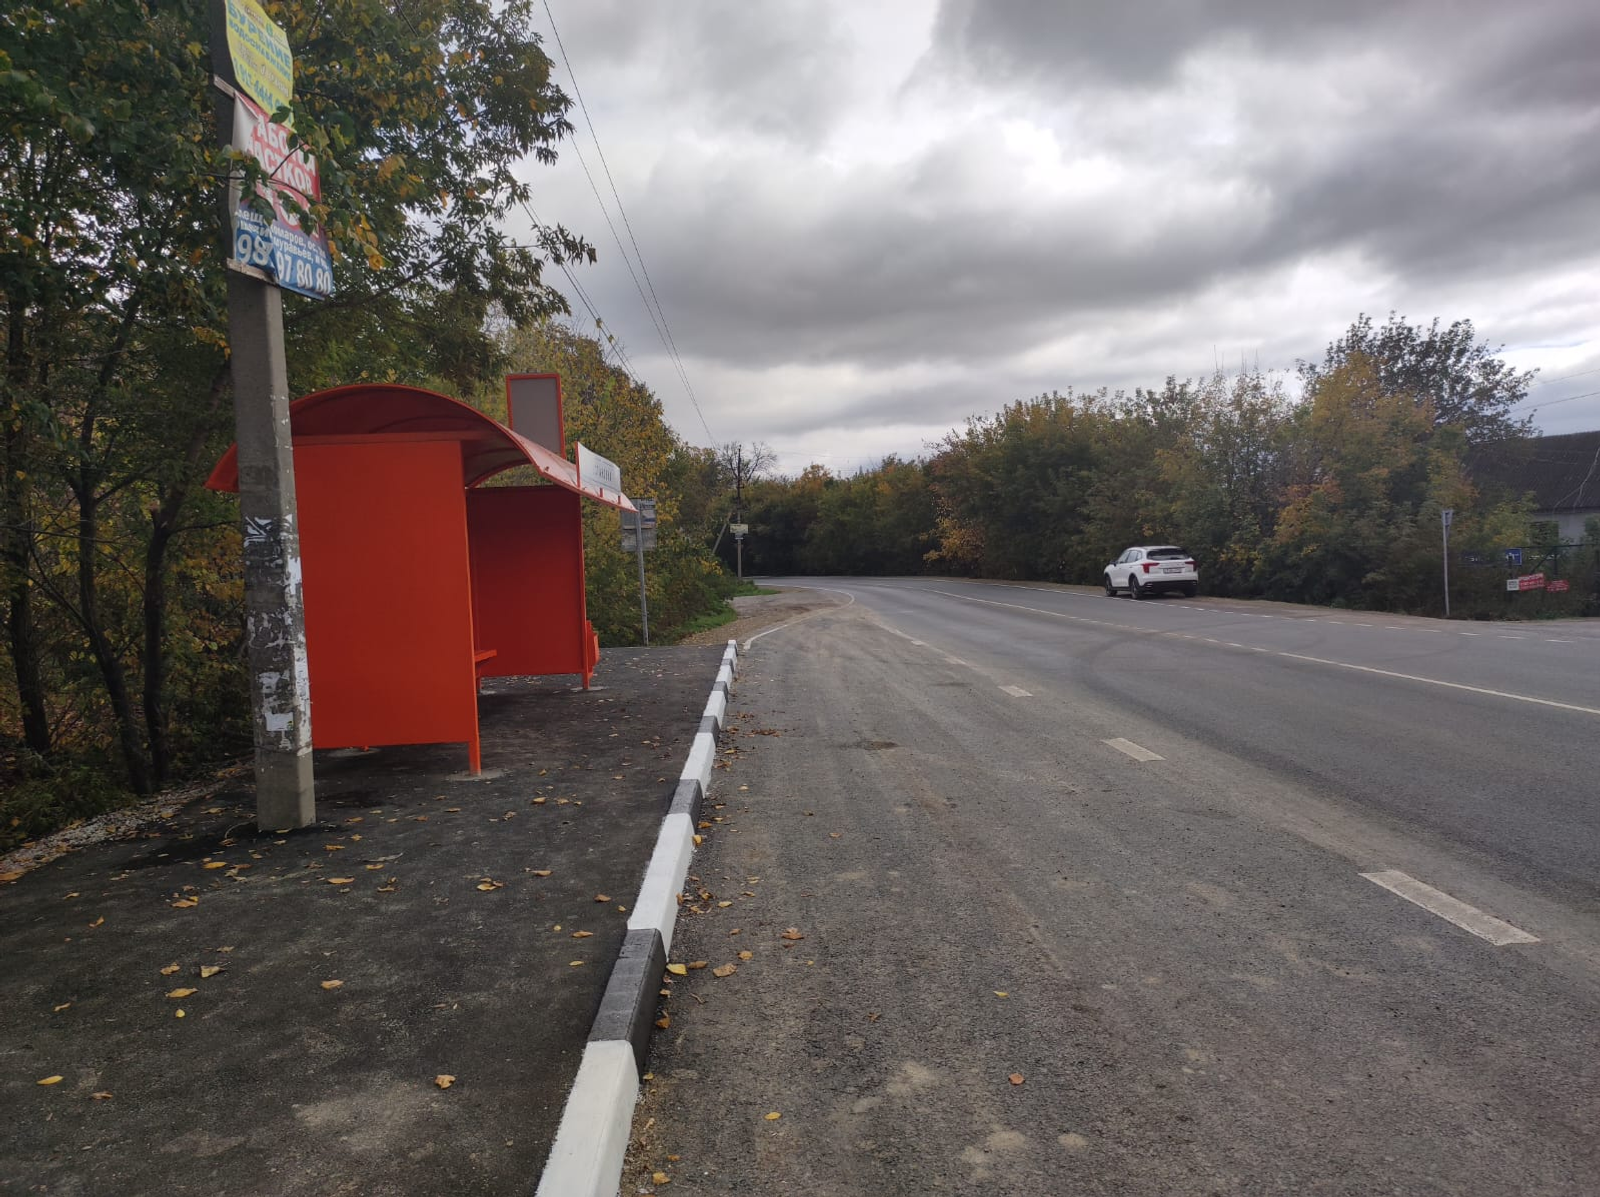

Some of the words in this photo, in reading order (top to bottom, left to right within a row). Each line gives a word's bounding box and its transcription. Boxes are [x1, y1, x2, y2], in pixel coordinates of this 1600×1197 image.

[277, 250, 292, 283] 97
[297, 259, 313, 290] 80
[316, 267, 331, 296] 80
